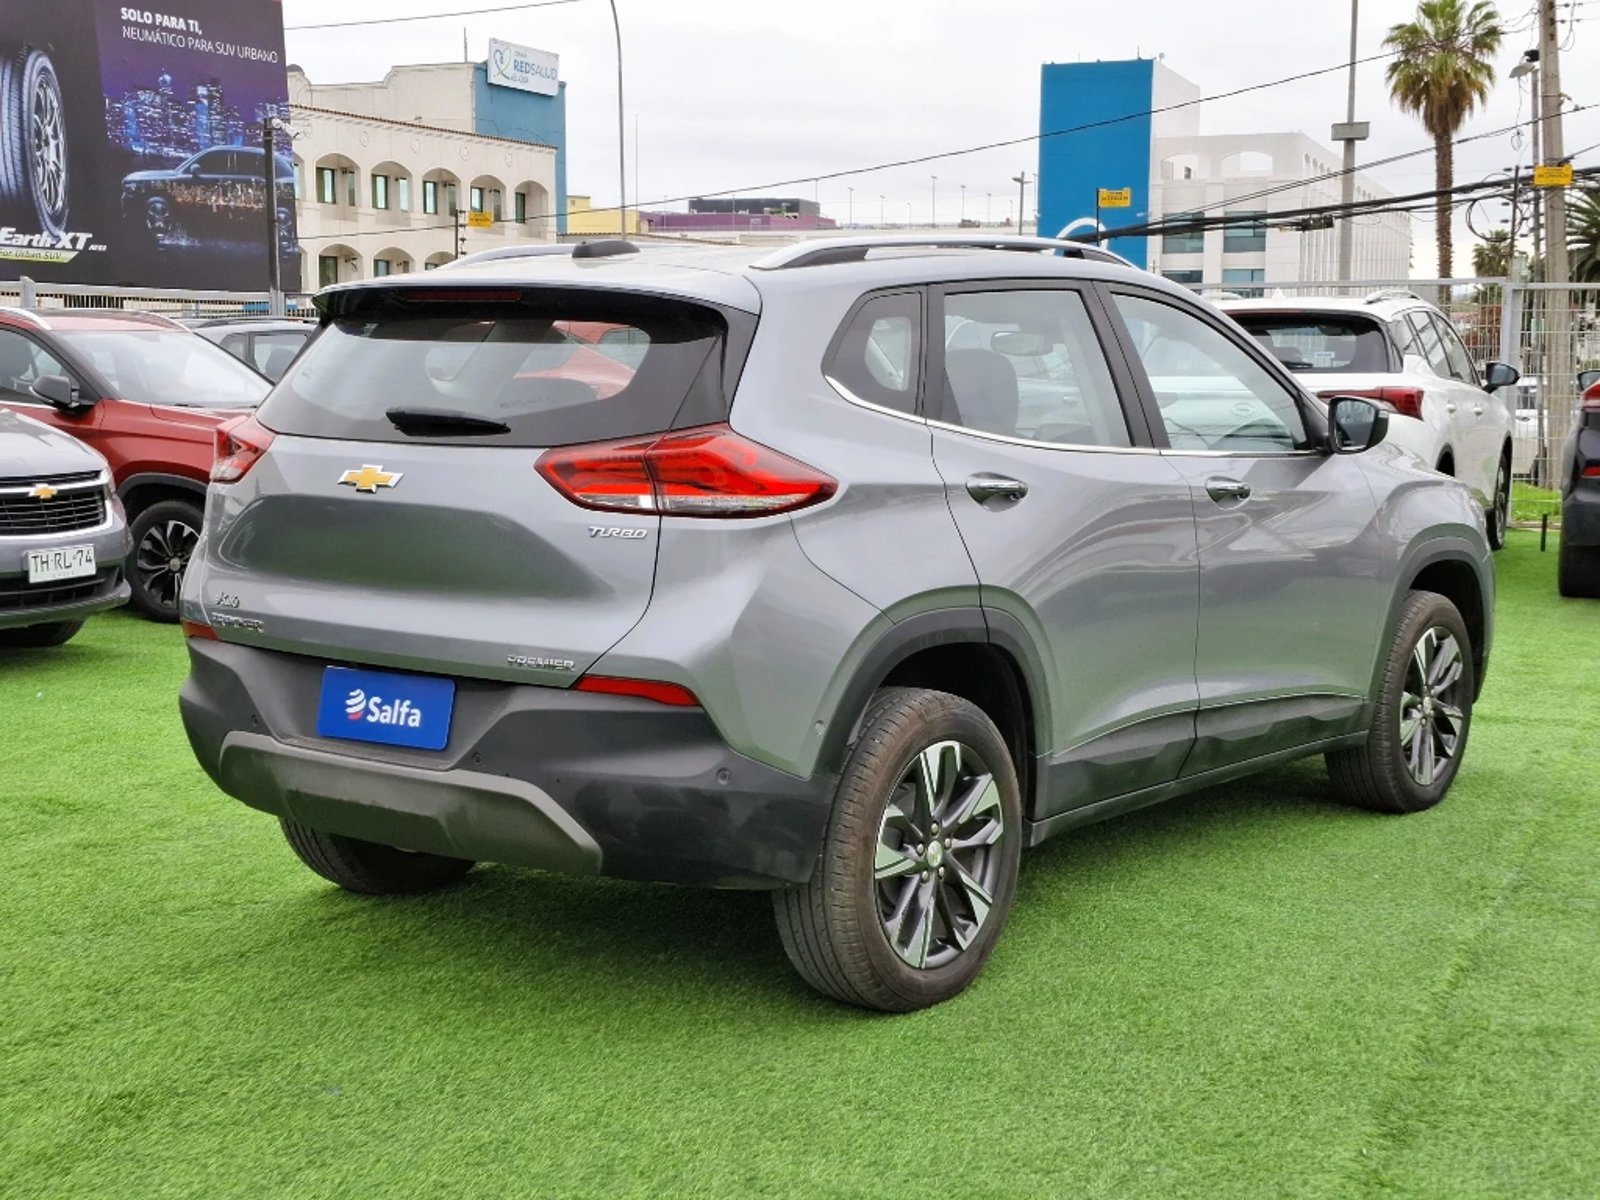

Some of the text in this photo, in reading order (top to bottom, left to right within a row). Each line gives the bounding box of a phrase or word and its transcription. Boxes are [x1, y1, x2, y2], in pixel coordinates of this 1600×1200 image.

[121, 7, 202, 35] SOLO PARA TI,
[122, 25, 278, 63] NEUMÁTICO PARA SUV URBANO
[513, 59, 558, 81] REDSALUD
[44, 251, 62, 260] SUV
[589, 526, 648, 540] TURBO
[507, 654, 576, 672] PREMIER
[366, 696, 421, 728] Salfa
